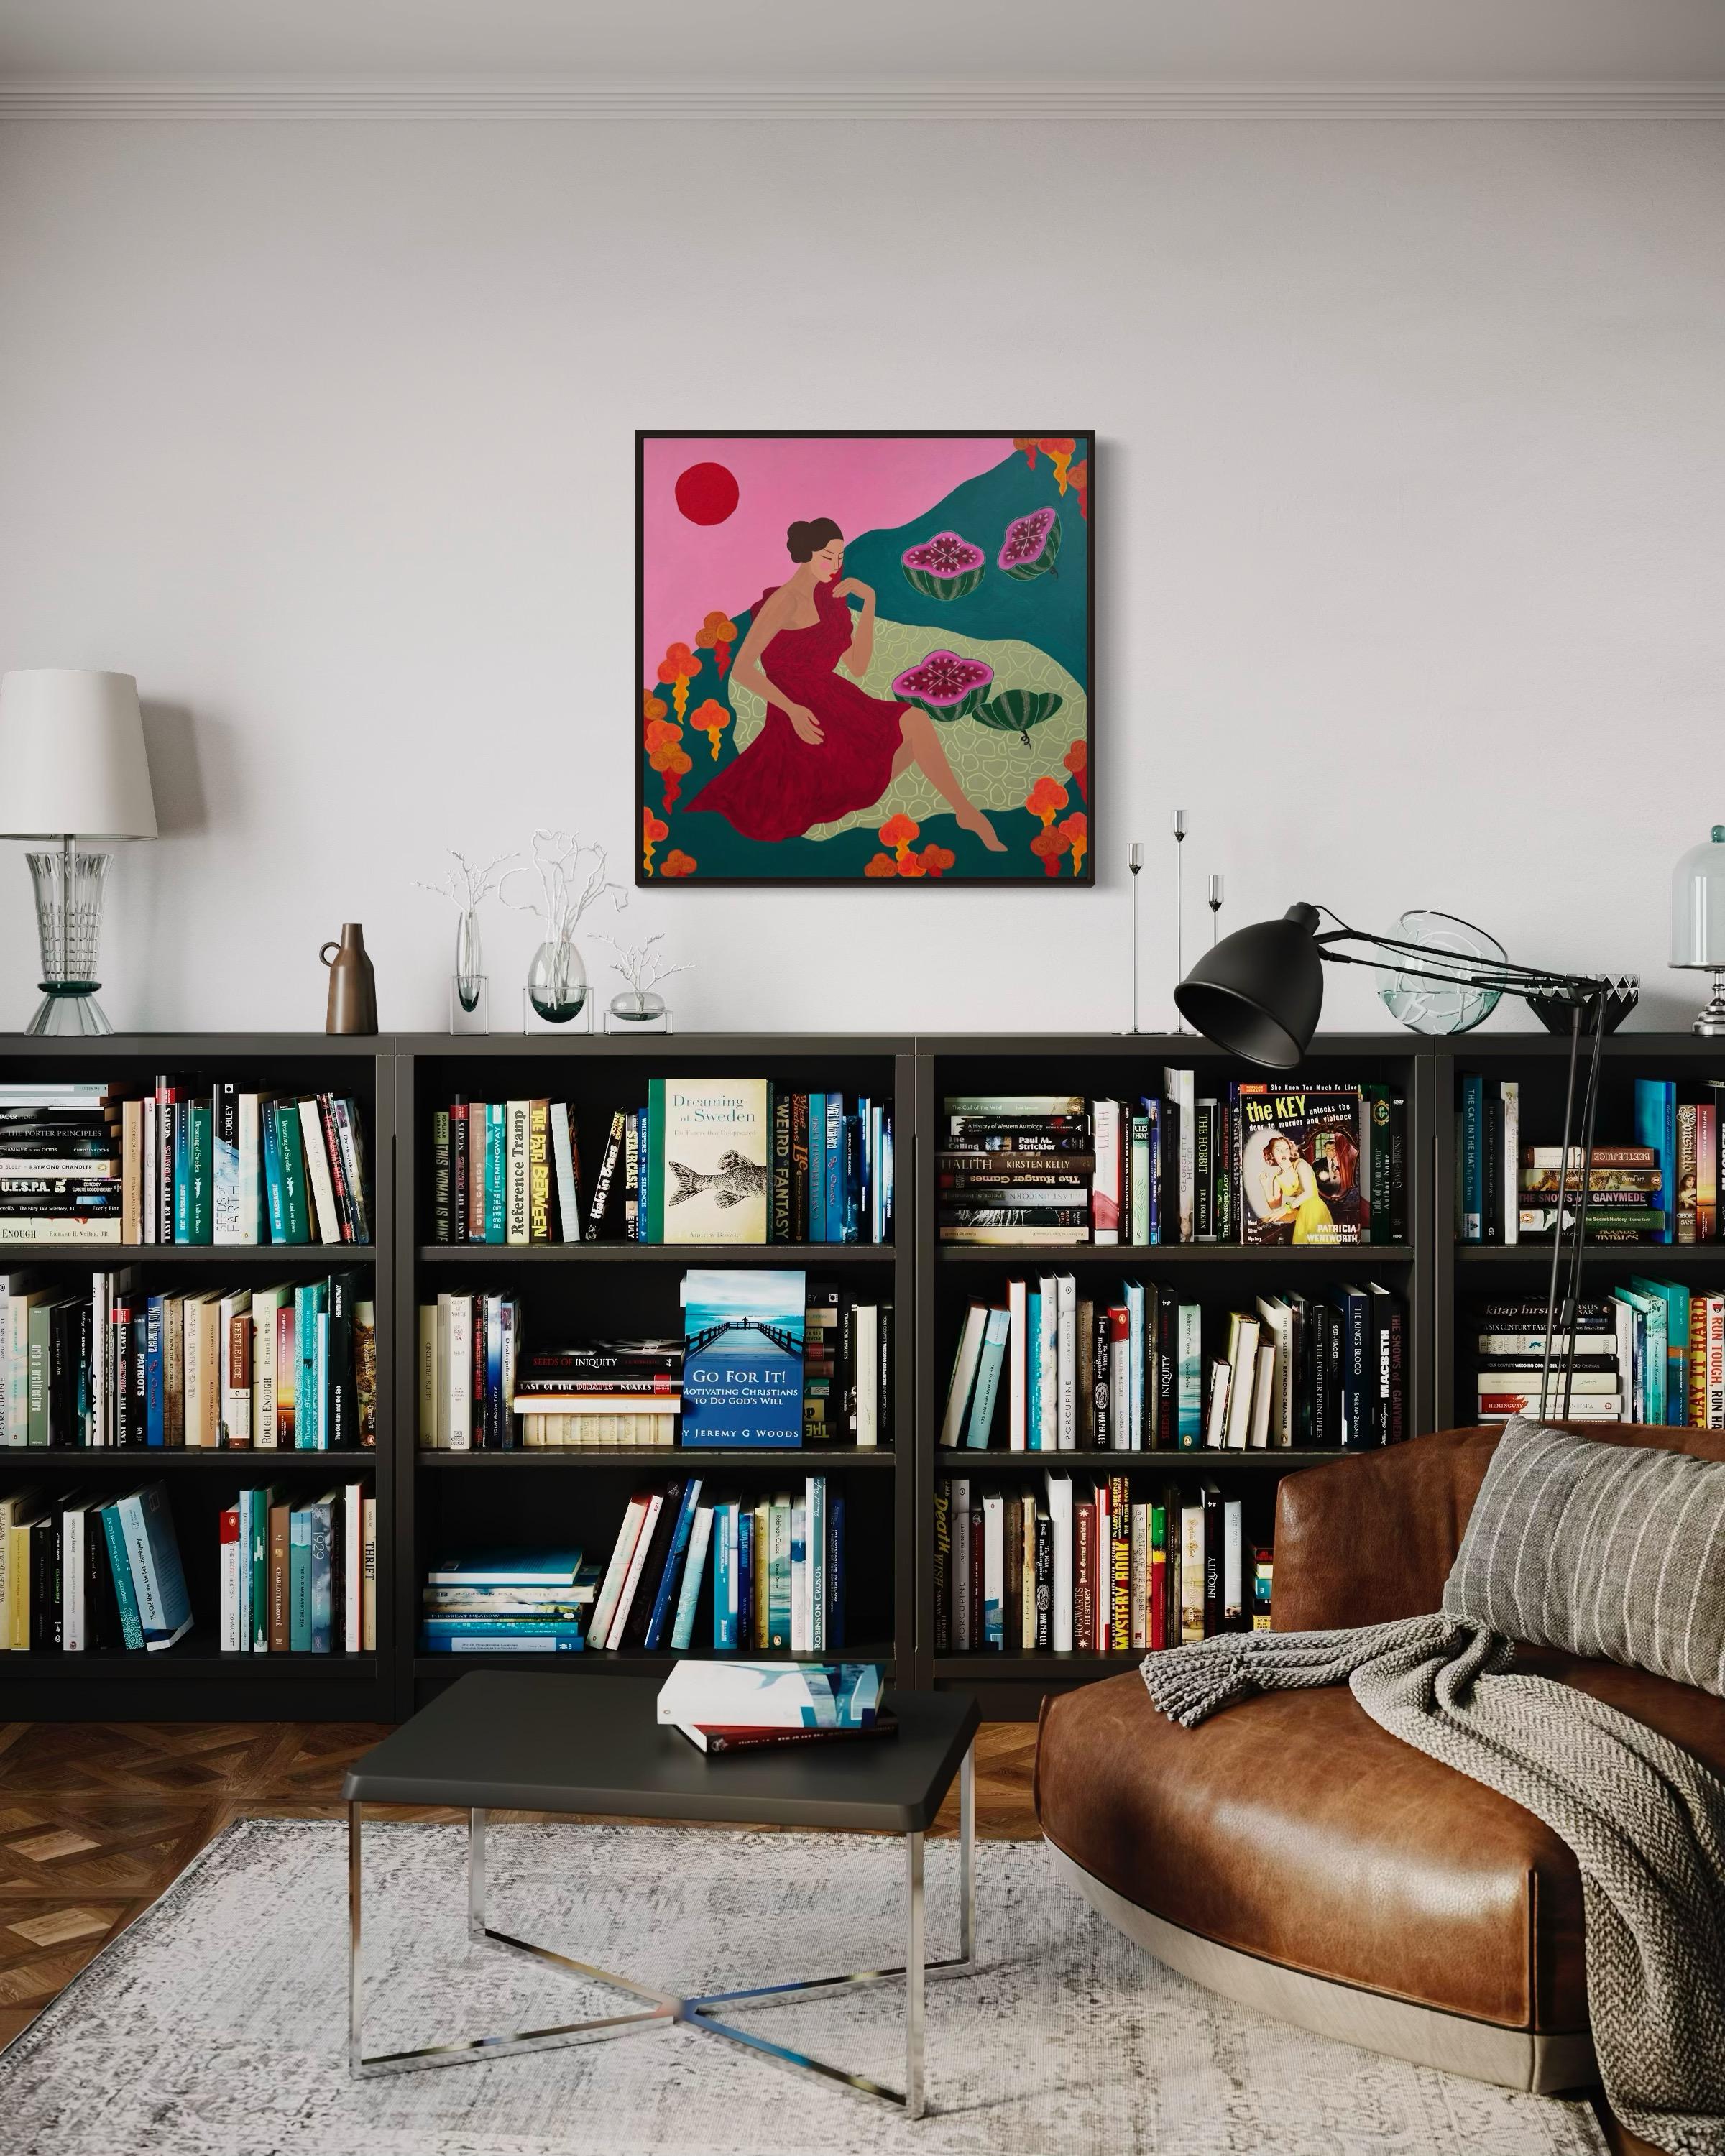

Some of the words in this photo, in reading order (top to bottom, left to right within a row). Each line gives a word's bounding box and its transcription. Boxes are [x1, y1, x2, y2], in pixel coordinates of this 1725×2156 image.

[674, 1095, 744, 1110] Dreaming
[800, 1094, 808, 1129] Where
[1246, 1101, 1273, 1123] the
[1275, 1095, 1306, 1119] KEY
[1309, 1105, 1335, 1115] unlocks
[530, 1106, 546, 1131] THE
[695, 1109, 755, 1122] Sweden
[1199, 1114, 1208, 1135] THE
[1249, 1123, 1264, 1132] door
[1279, 1119, 1303, 1128] murder
[1322, 1114, 1352, 1123] violence
[511, 1110, 526, 1157] Tramp
[1468, 1125, 1475, 1133] IN
[530, 1134, 546, 1163] PATH
[626, 1130, 638, 1189] STAIRCASE
[793, 1143, 809, 1171] Lie
[1199, 1137, 1208, 1174] HOBBIT
[54, 1181, 66, 1193] 5
[970, 1175, 1010, 1184] Games
[1013, 1175, 1055, 1184] Hunger
[1374, 1170, 1383, 1187] your
[511, 1162, 524, 1235] Reference
[531, 1166, 549, 1237] BETWEEN
[1372, 1188, 1381, 1197] of
[1593, 1193, 1646, 1202] GANYMEDE
[164, 1206, 171, 1216] OF
[1372, 1198, 1381, 1216] Title
[1307, 1234, 1358, 1243] WENTWORTH
[1317, 1224, 1357, 1233] PATRICIA
[1392, 1313, 1401, 1332] THE
[1486, 1305, 1517, 1316] kitap
[1691, 1298, 1707, 1353] HARD
[1712, 1317, 1722, 1340] RUN
[533, 1358, 559, 1366] SEEDS
[561, 1358, 573, 1366] OF
[575, 1358, 617, 1368] INIQUITY
[1380, 1330, 1389, 1398] MACBETH
[1392, 1335, 1401, 1369] SNOWS
[137, 1353, 145, 1396] PATRIOTS
[692, 1370, 719, 1383] GO
[726, 1370, 759, 1383] FOR
[765, 1371, 786, 1383] IT!
[1162, 1355, 1172, 1397] INIQUITY
[1392, 1372, 1401, 1381] of
[1690, 1359, 1706, 1378] IT
[1710, 1345, 1722, 1387] TOUGH,
[262, 1378, 272, 1412] ENOUGH
[728, 1397, 757, 1405] GOD'S
[1711, 1391, 1722, 1411] RUN
[1392, 1390, 1402, 1443] GANYMEDE
[262, 1415, 272, 1444] ROUGH
[694, 1430, 737, 1438] JEREMY
[934, 1493, 951, 1553] Death
[313, 1532, 325, 1560] 1929
[365, 1542, 374, 1581] THRIFT
[1115, 1540, 1129, 1580] BOOK
[1208, 1556, 1218, 1598] INIQUITY
[1075, 1587, 1084, 1637] HOGWARTS
[1116, 1586, 1129, 1650] MYSTERY
